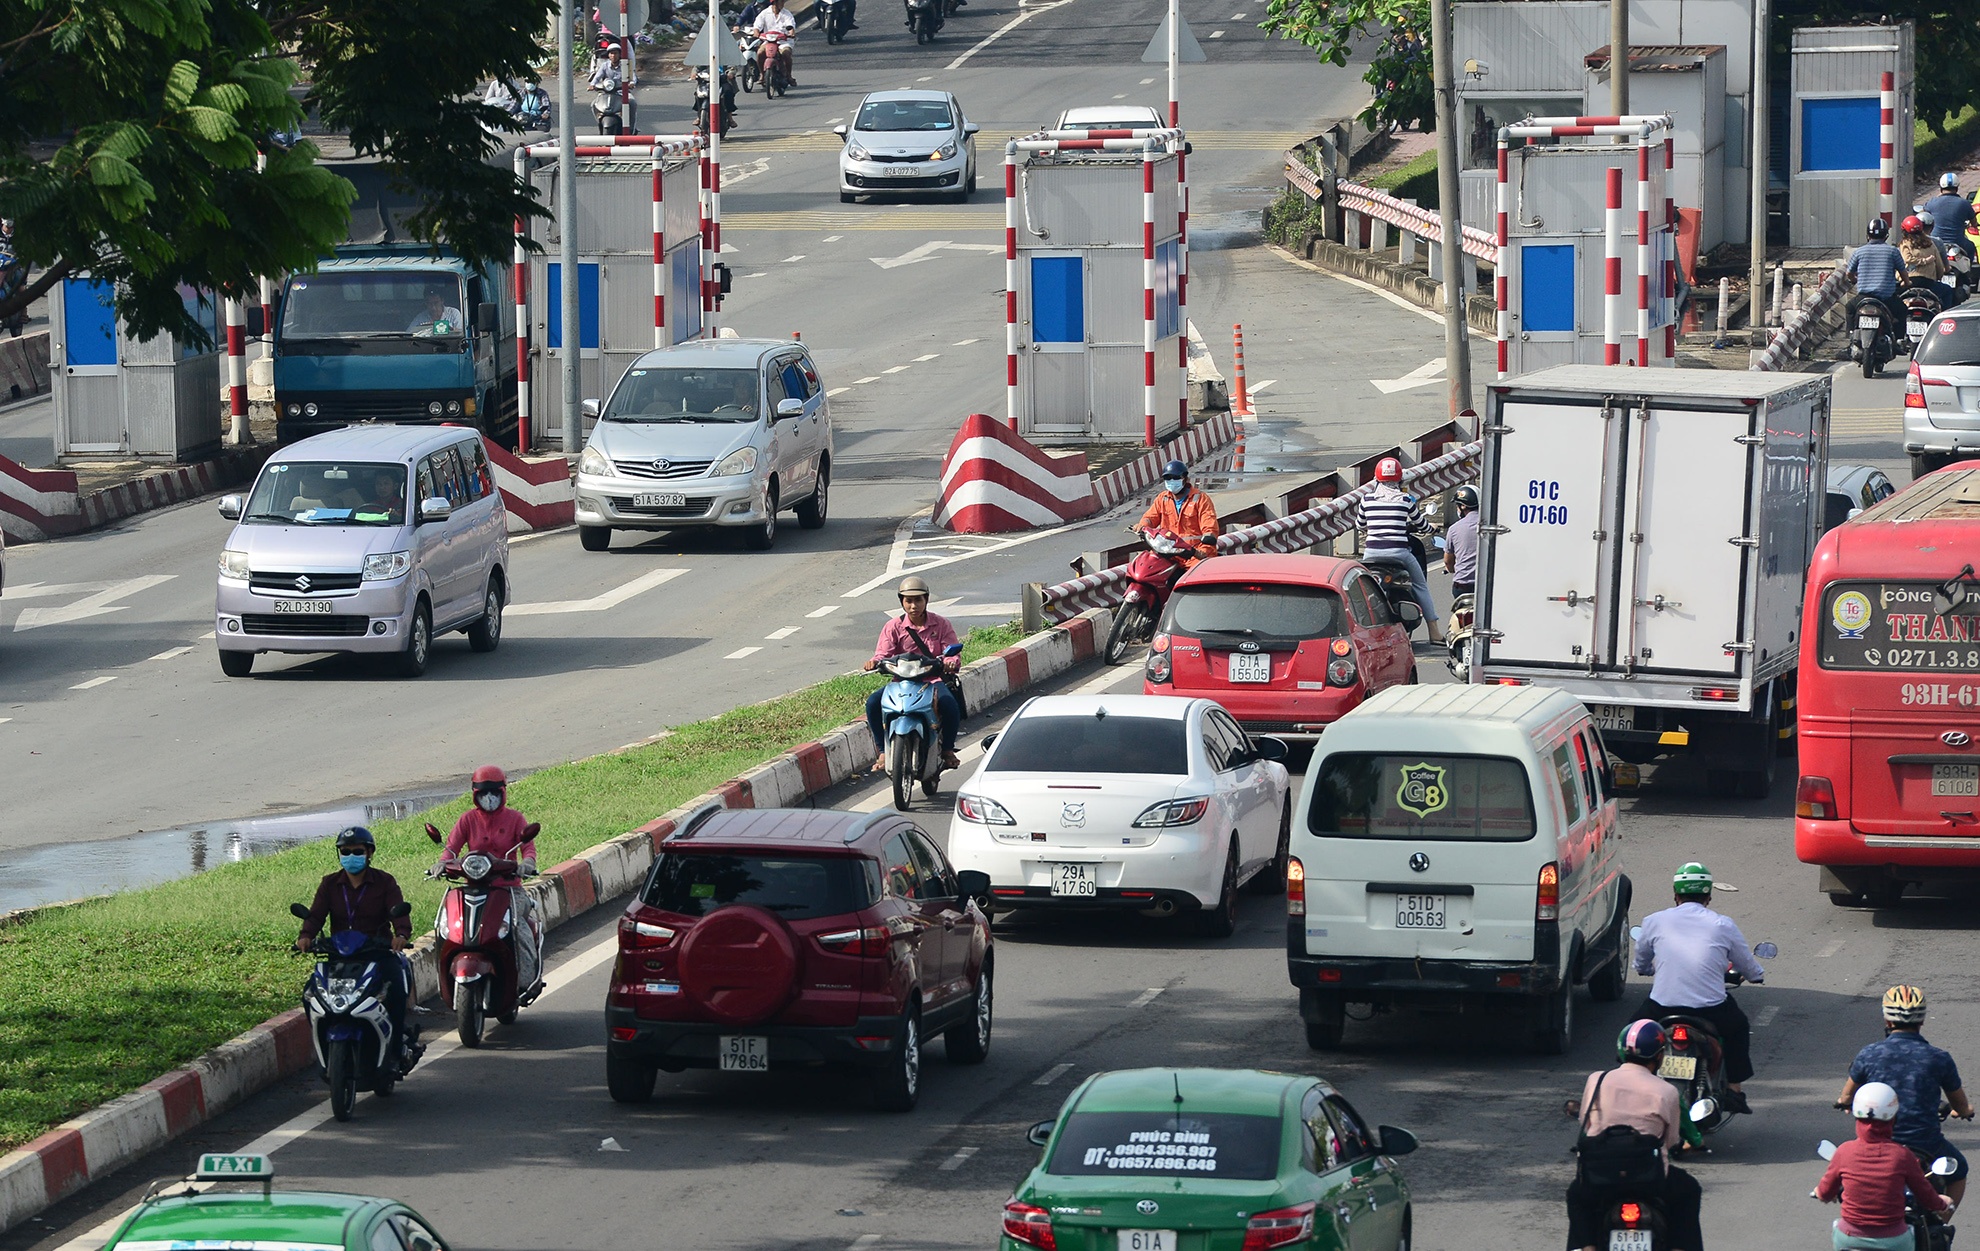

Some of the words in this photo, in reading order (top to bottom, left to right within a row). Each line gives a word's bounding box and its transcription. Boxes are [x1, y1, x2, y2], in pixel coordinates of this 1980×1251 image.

[1940, 322, 1954, 333] 702
[635, 495, 684, 505] 51A-537.82
[1519, 504, 1568, 525] 071.60
[1884, 588, 1932, 602] CÔNG
[275, 601, 331, 613] 52LD-3190
[1239, 655, 1260, 668] 61A
[1887, 648, 1979, 668] 0271.3.8
[1232, 668, 1268, 681] 155.05
[1603, 705, 1626, 719] 61C
[1410, 771, 1436, 780] Coffee
[1943, 765, 1969, 779] 93H
[1404, 780, 1441, 807] G8
[1938, 780, 1973, 794] 6108
[1062, 865, 1086, 880] 29A
[1053, 880, 1095, 895] 417.60
[1408, 895, 1434, 911] 51D
[1398, 911, 1444, 927] 005.63
[730, 1037, 756, 1053] 51F
[722, 1053, 767, 1070] 178.64
[1129, 1130, 1171, 1143] PHÚC
[1173, 1130, 1210, 1144] BÌNH
[1114, 1144, 1217, 1158] 0964.356.987
[1107, 1157, 1217, 1171] 01657.696.648
[1131, 1232, 1162, 1251] 61A
